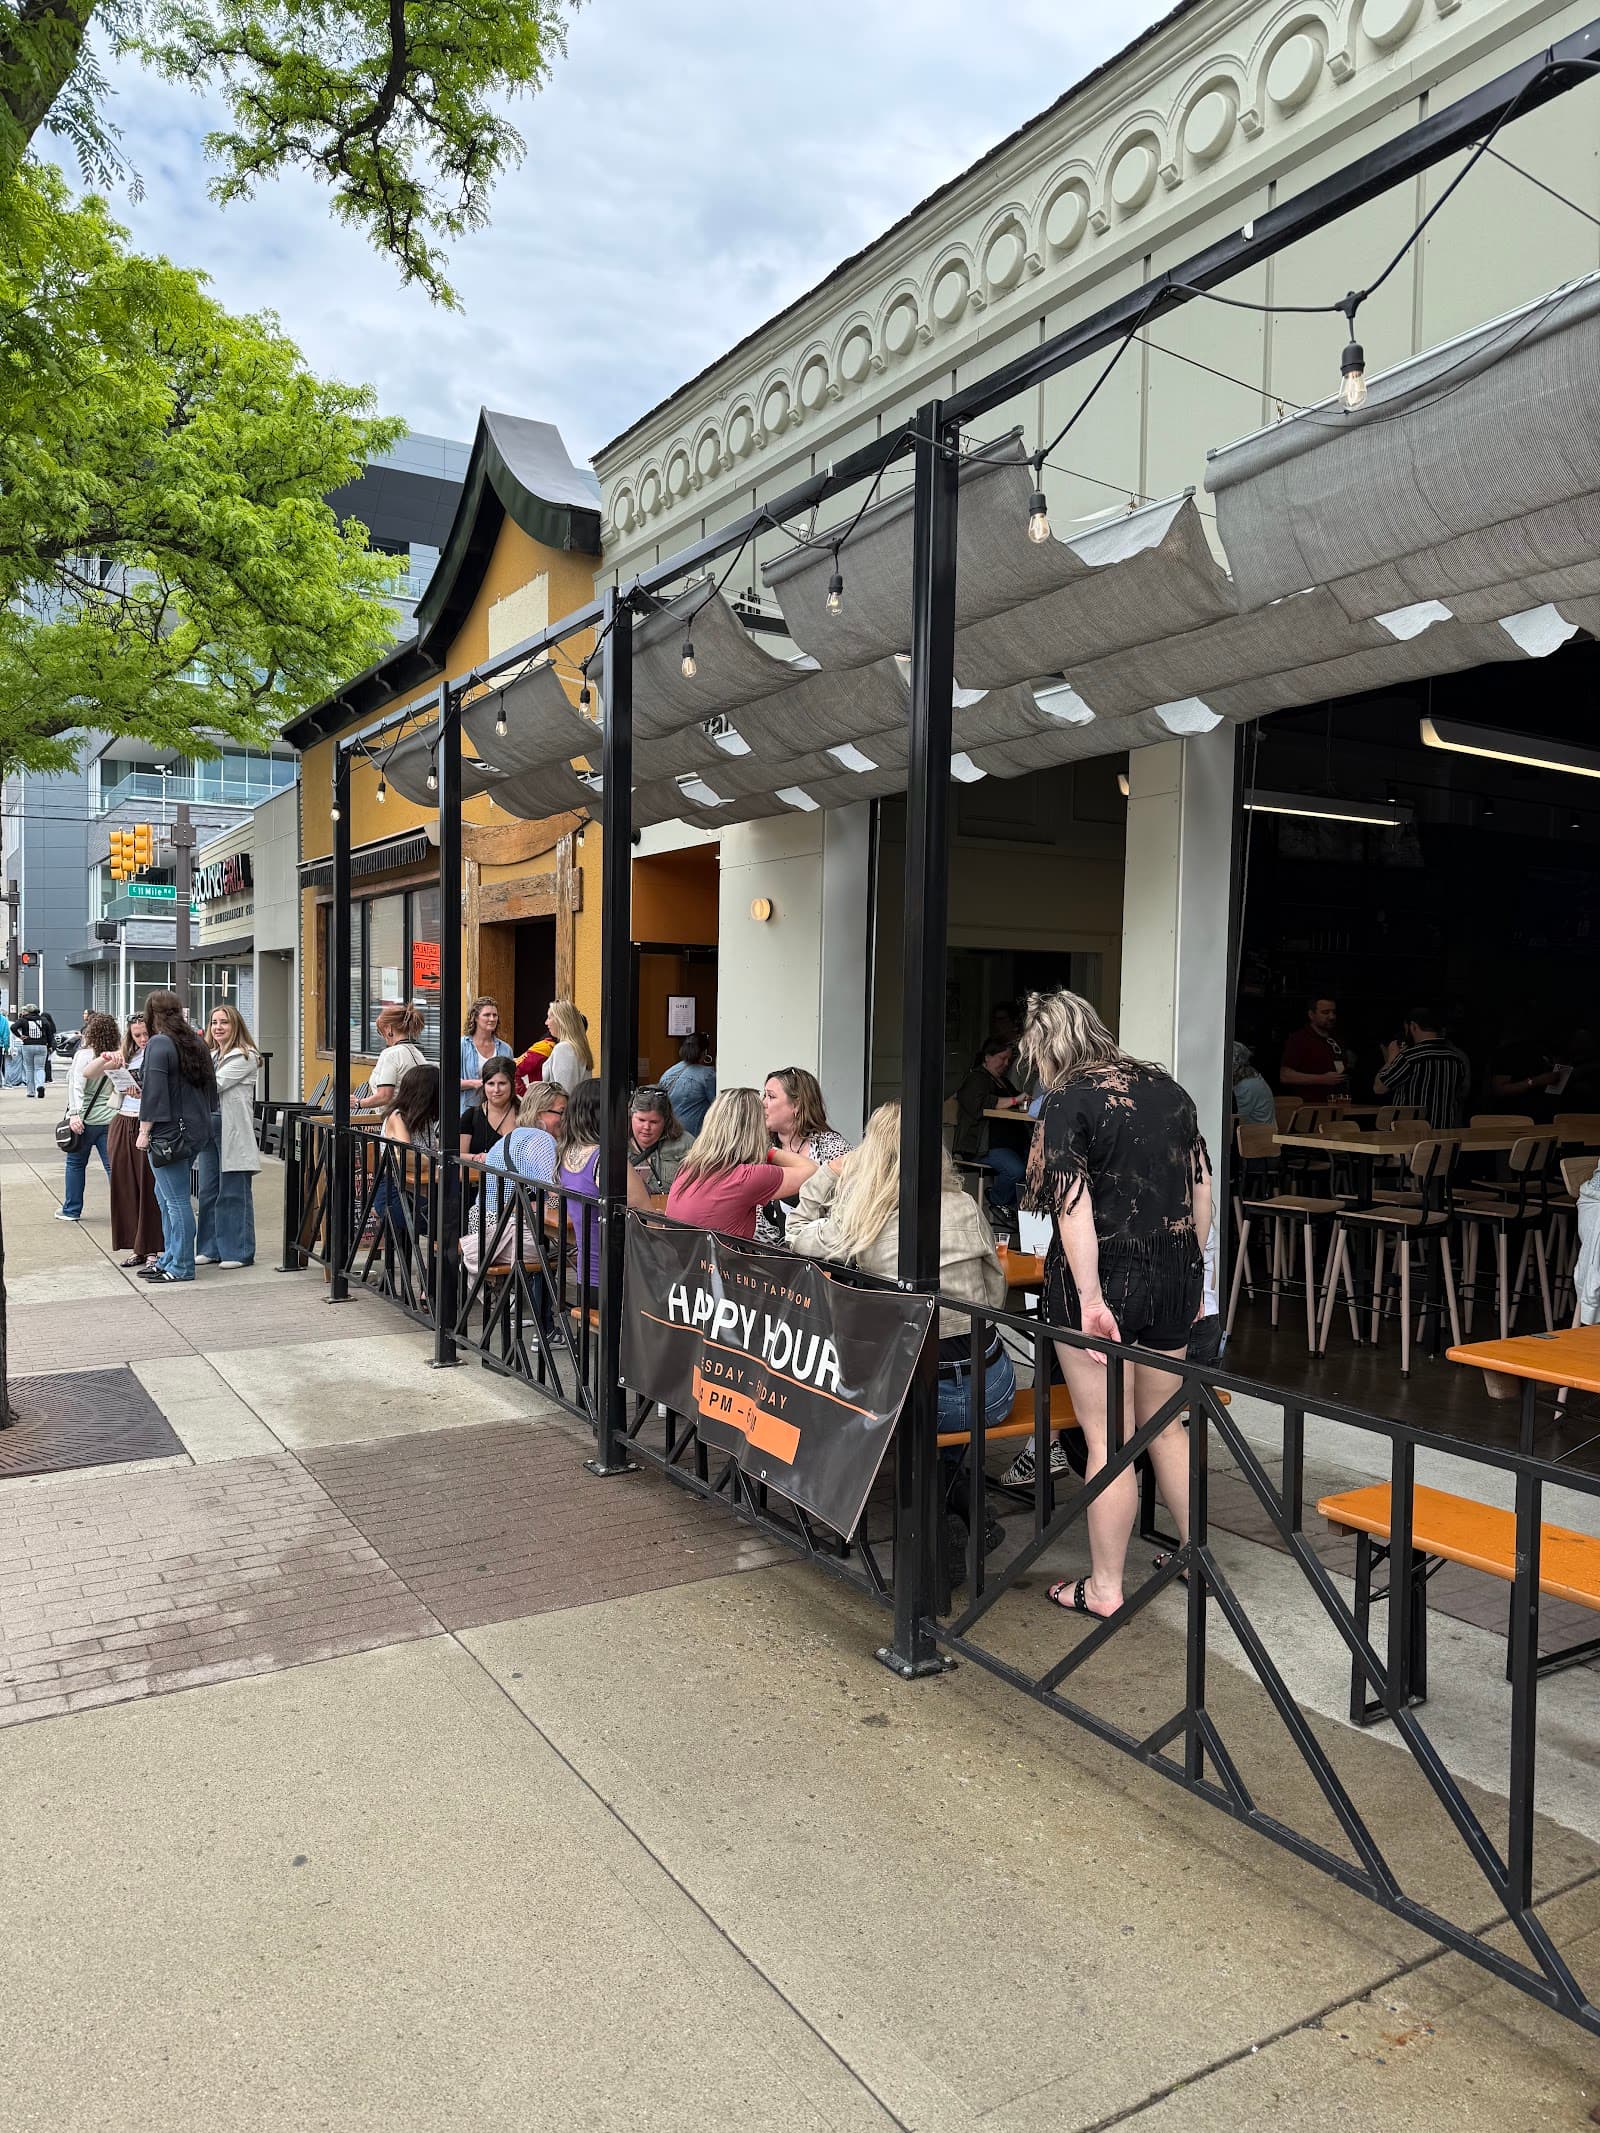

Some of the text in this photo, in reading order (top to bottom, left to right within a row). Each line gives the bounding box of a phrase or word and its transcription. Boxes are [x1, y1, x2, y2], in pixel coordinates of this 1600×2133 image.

[138, 887, 144, 896] 11
[145, 887, 163, 897] Mile
[736, 1273, 757, 1289] END
[668, 1282, 841, 1394] HAPPY HOUR
[709, 1391, 733, 1413] PM
